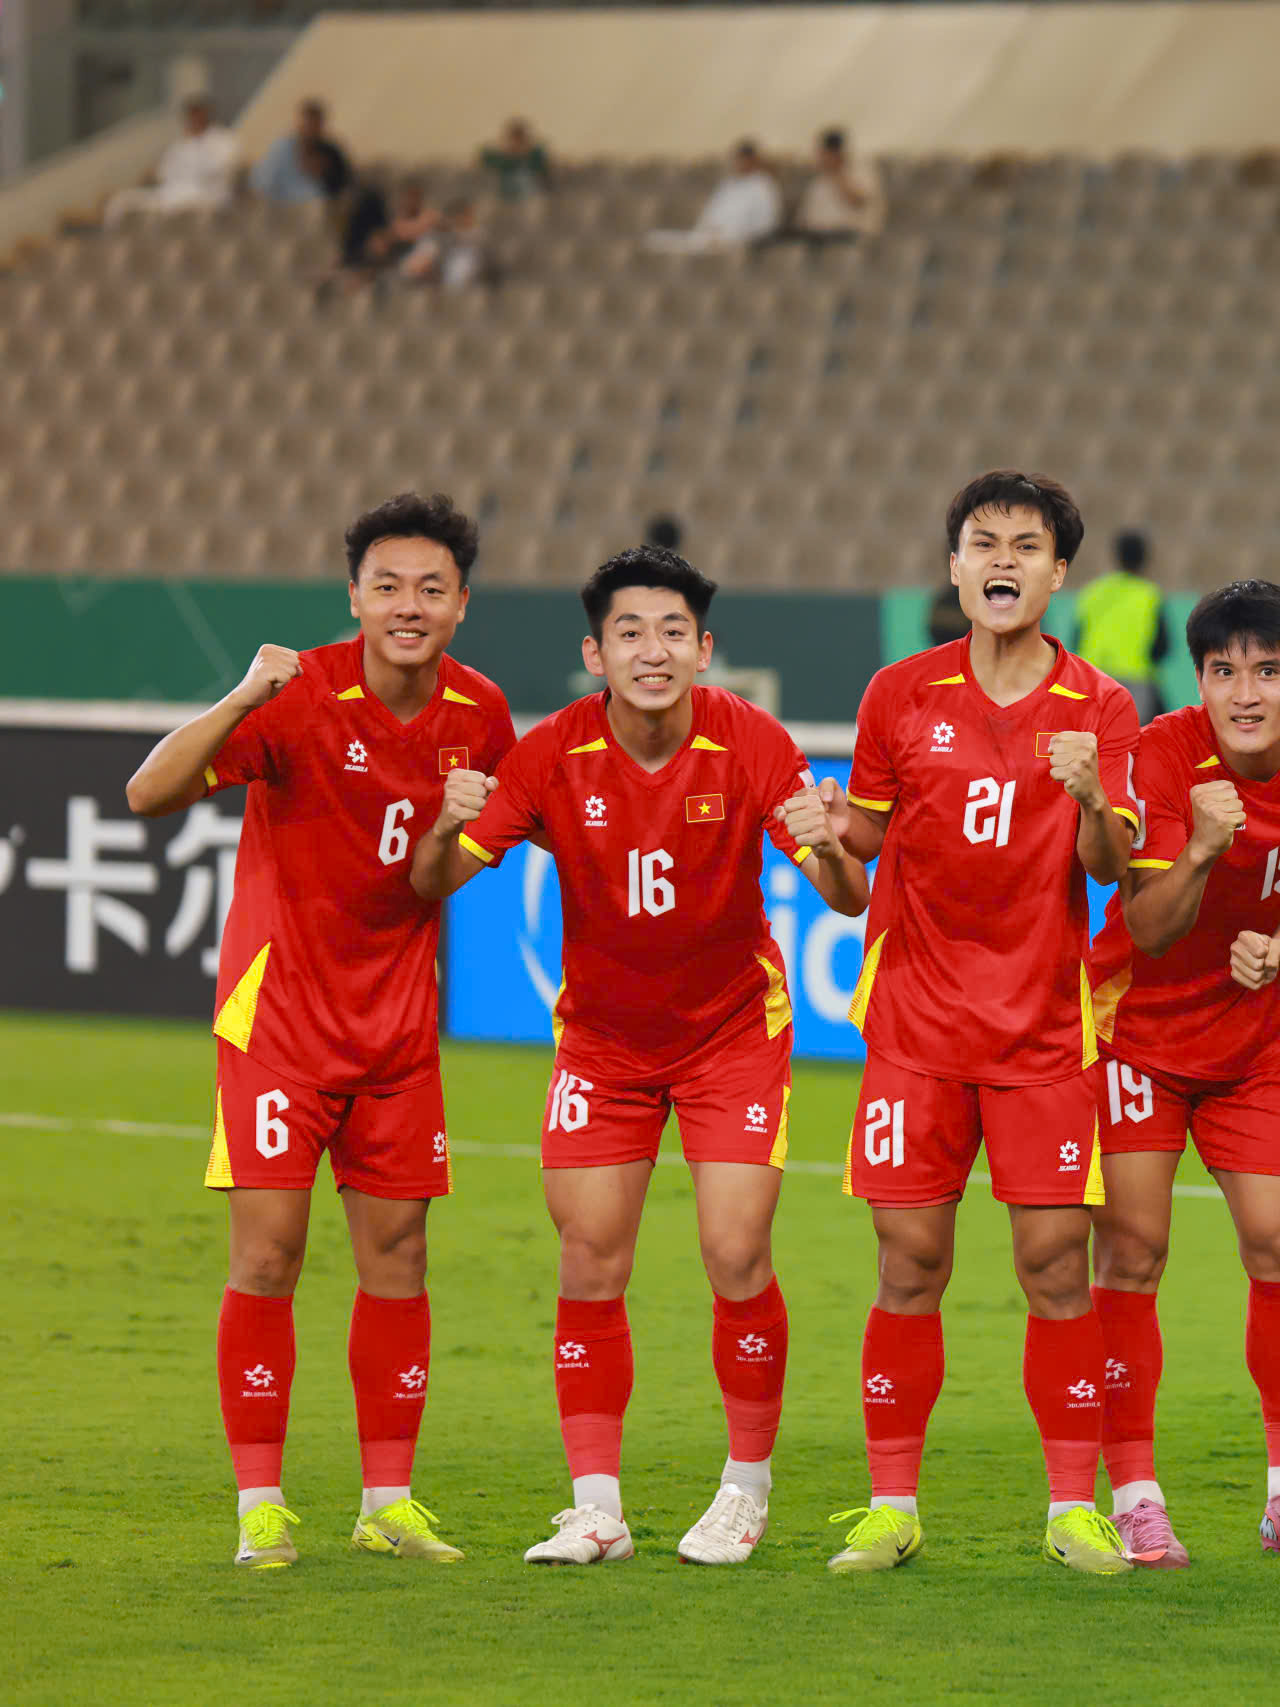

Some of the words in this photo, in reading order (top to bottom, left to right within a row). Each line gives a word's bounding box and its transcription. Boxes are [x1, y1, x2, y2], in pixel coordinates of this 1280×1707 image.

[377, 798, 415, 866] 6
[962, 776, 1017, 848] 21
[628, 847, 676, 918] 16
[255, 1088, 290, 1160] 6
[547, 1068, 594, 1133] 16
[1106, 1059, 1155, 1126] 19
[864, 1097, 905, 1168] 21
